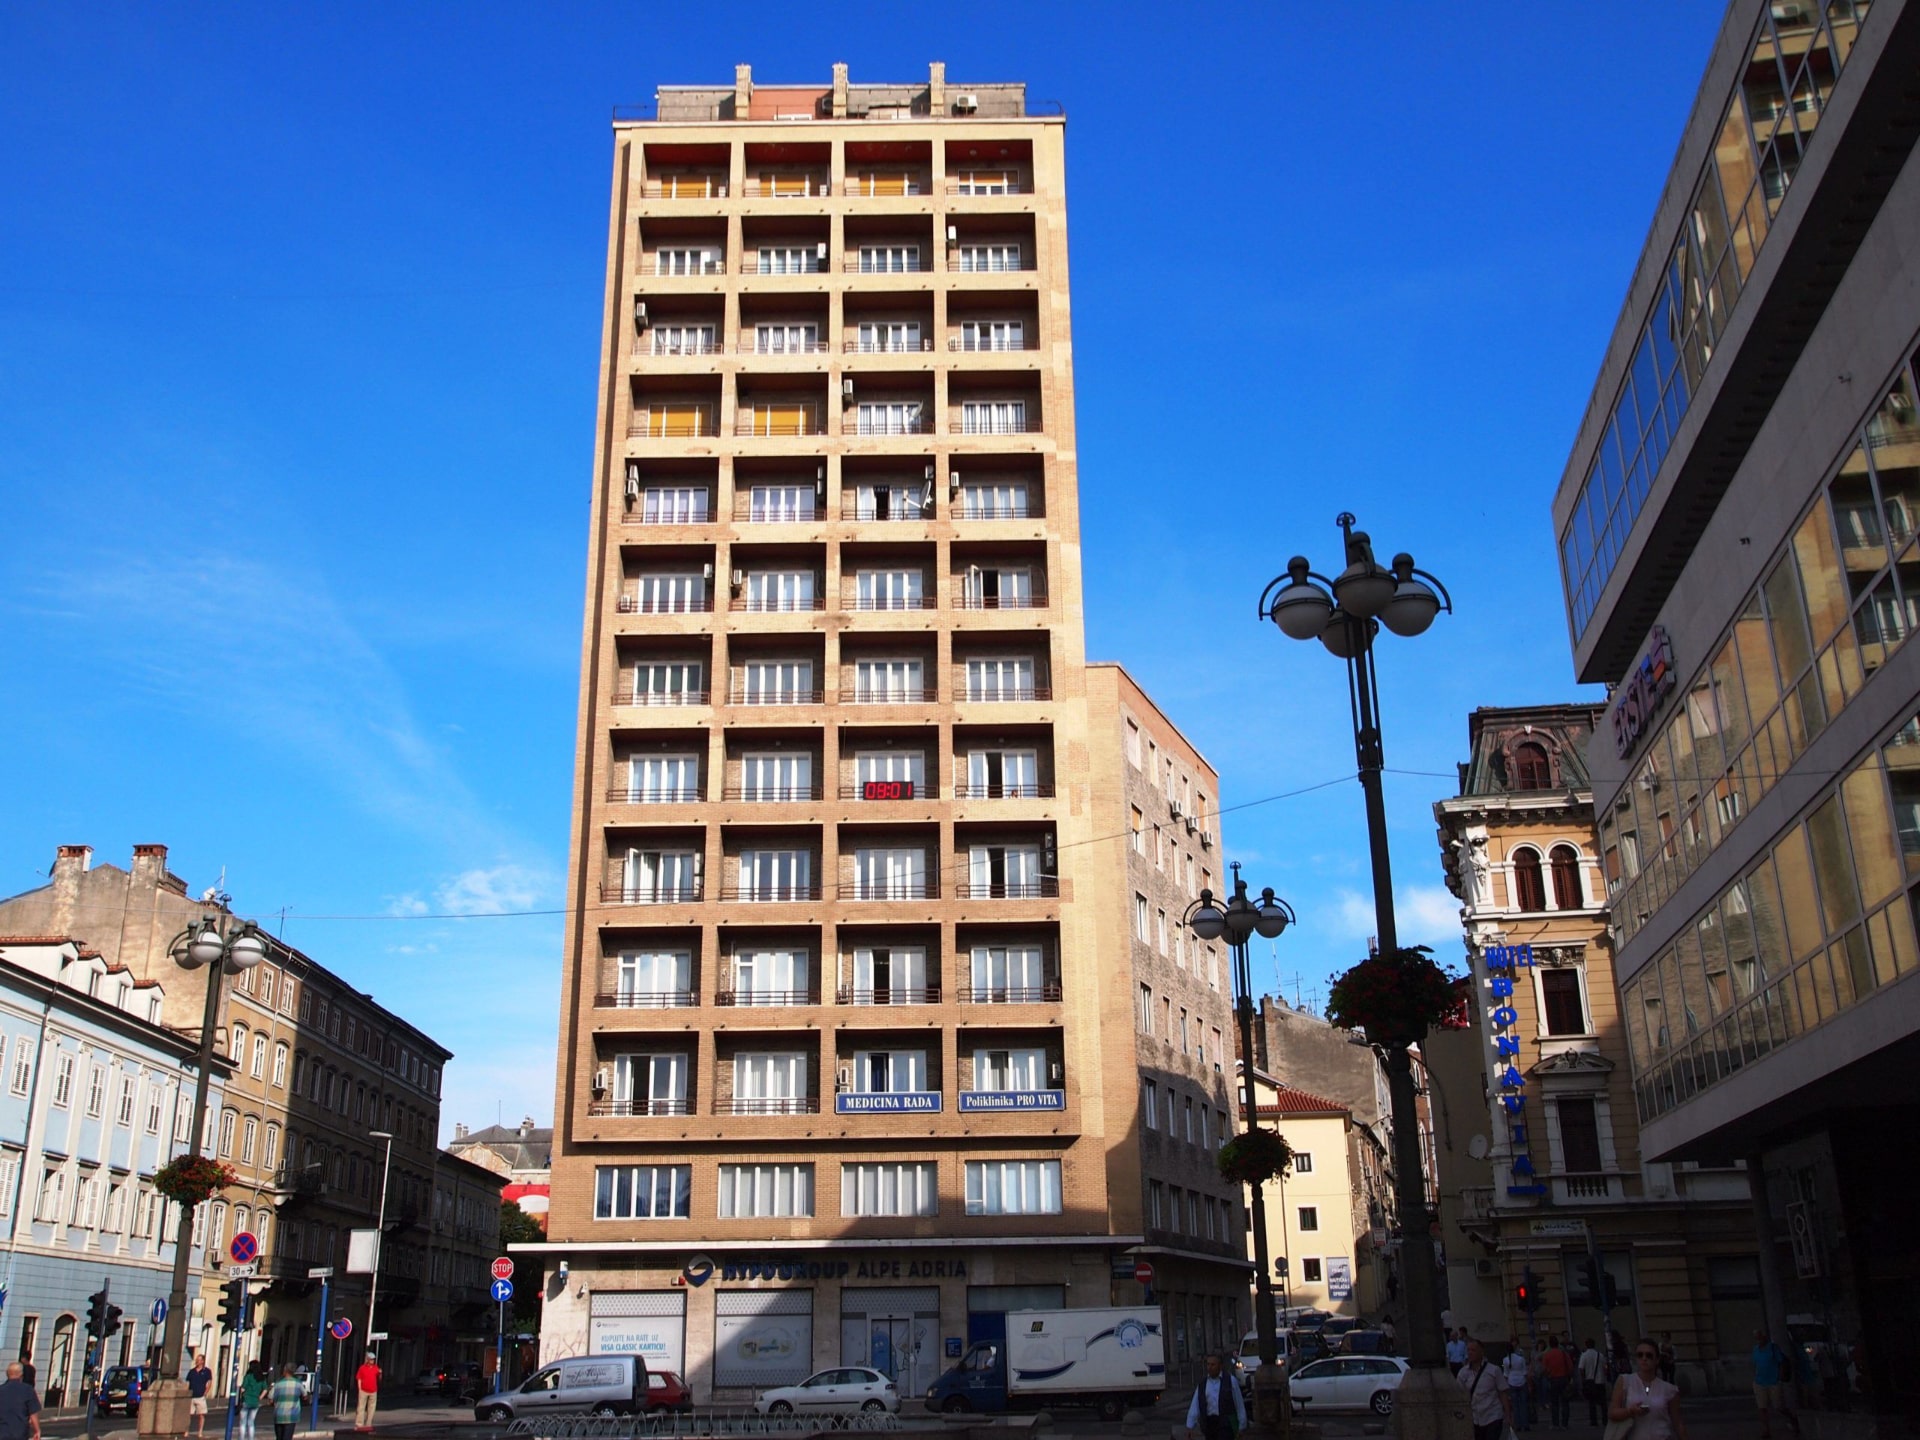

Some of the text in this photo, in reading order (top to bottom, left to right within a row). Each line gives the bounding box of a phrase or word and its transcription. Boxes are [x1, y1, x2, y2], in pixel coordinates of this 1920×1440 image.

[1485, 944, 1536, 968] HOTEL
[1490, 977, 1536, 1176] BONAVIA
[846, 1096, 932, 1108] MEDICINA RADA
[966, 1094, 1058, 1107] Poliklinika PRO VITA
[231, 1267, 240, 1276] 30
[722, 1261, 776, 1280] HYPO
[857, 1260, 900, 1278] ALPE
[909, 1260, 967, 1277] ADRIA
[601, 1343, 614, 1351] VISA
[615, 1343, 637, 1351] CLASSIC
